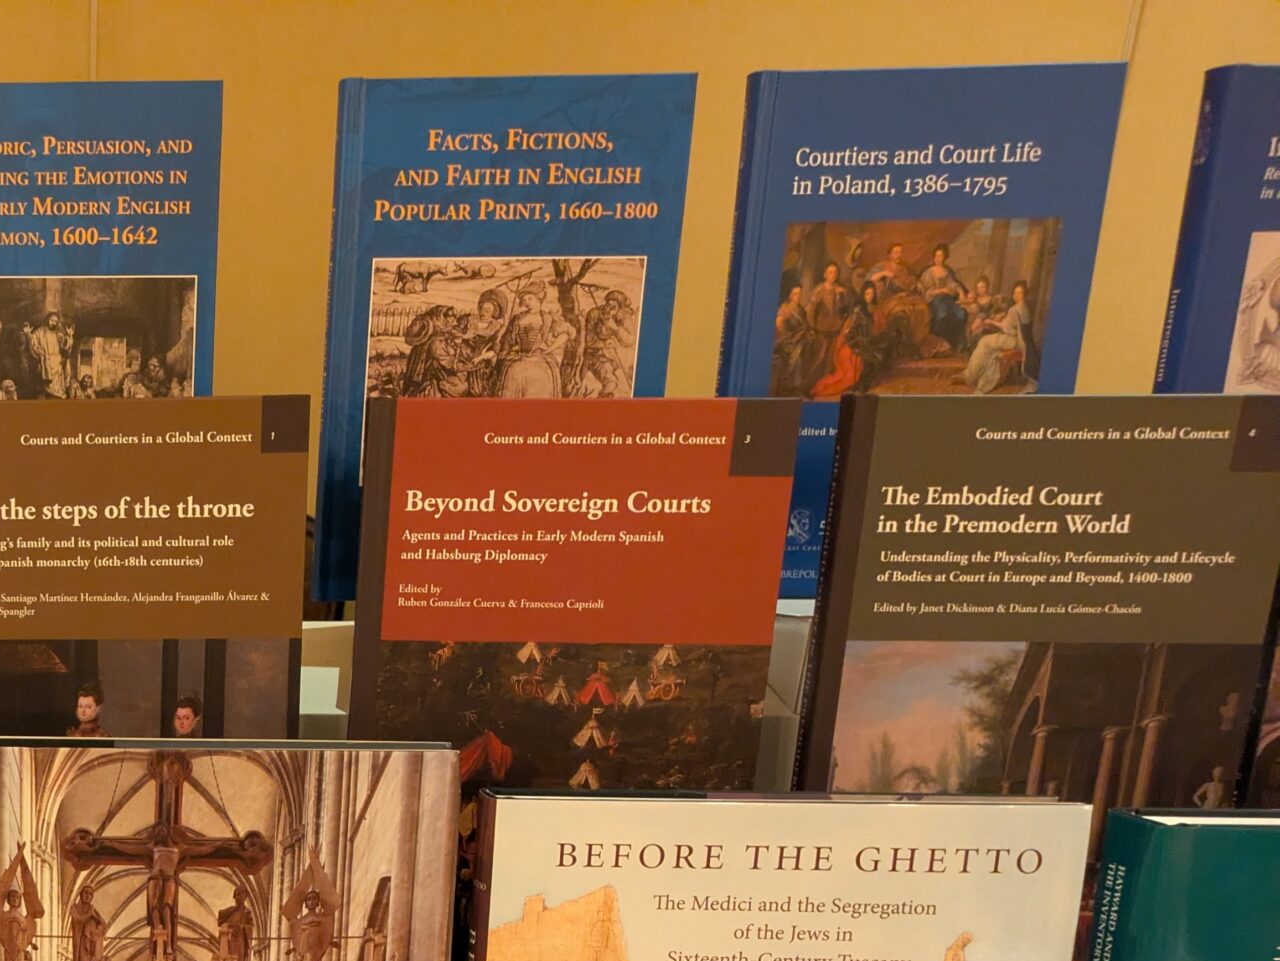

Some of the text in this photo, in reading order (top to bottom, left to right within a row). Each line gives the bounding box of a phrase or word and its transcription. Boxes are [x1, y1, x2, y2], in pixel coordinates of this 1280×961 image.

[796, 142, 1042, 166] Courtiers and Court Life
[792, 176, 812, 195] in
[819, 174, 896, 196] Poland,
[404, 489, 711, 520] Beyond Sovereign Courts
[881, 485, 1103, 506] The Embodied Court
[0, 497, 36, 520] the
[42, 504, 98, 526] steps
[104, 496, 131, 519] of
[134, 496, 170, 518] the
[177, 496, 254, 518] throne
[877, 513, 1131, 534] in the Premodern World
[398, 597, 604, 612] Ruben González Cuerva & Francesco Caprioli
[556, 843, 1042, 874] BEFORE THE GHETTO
